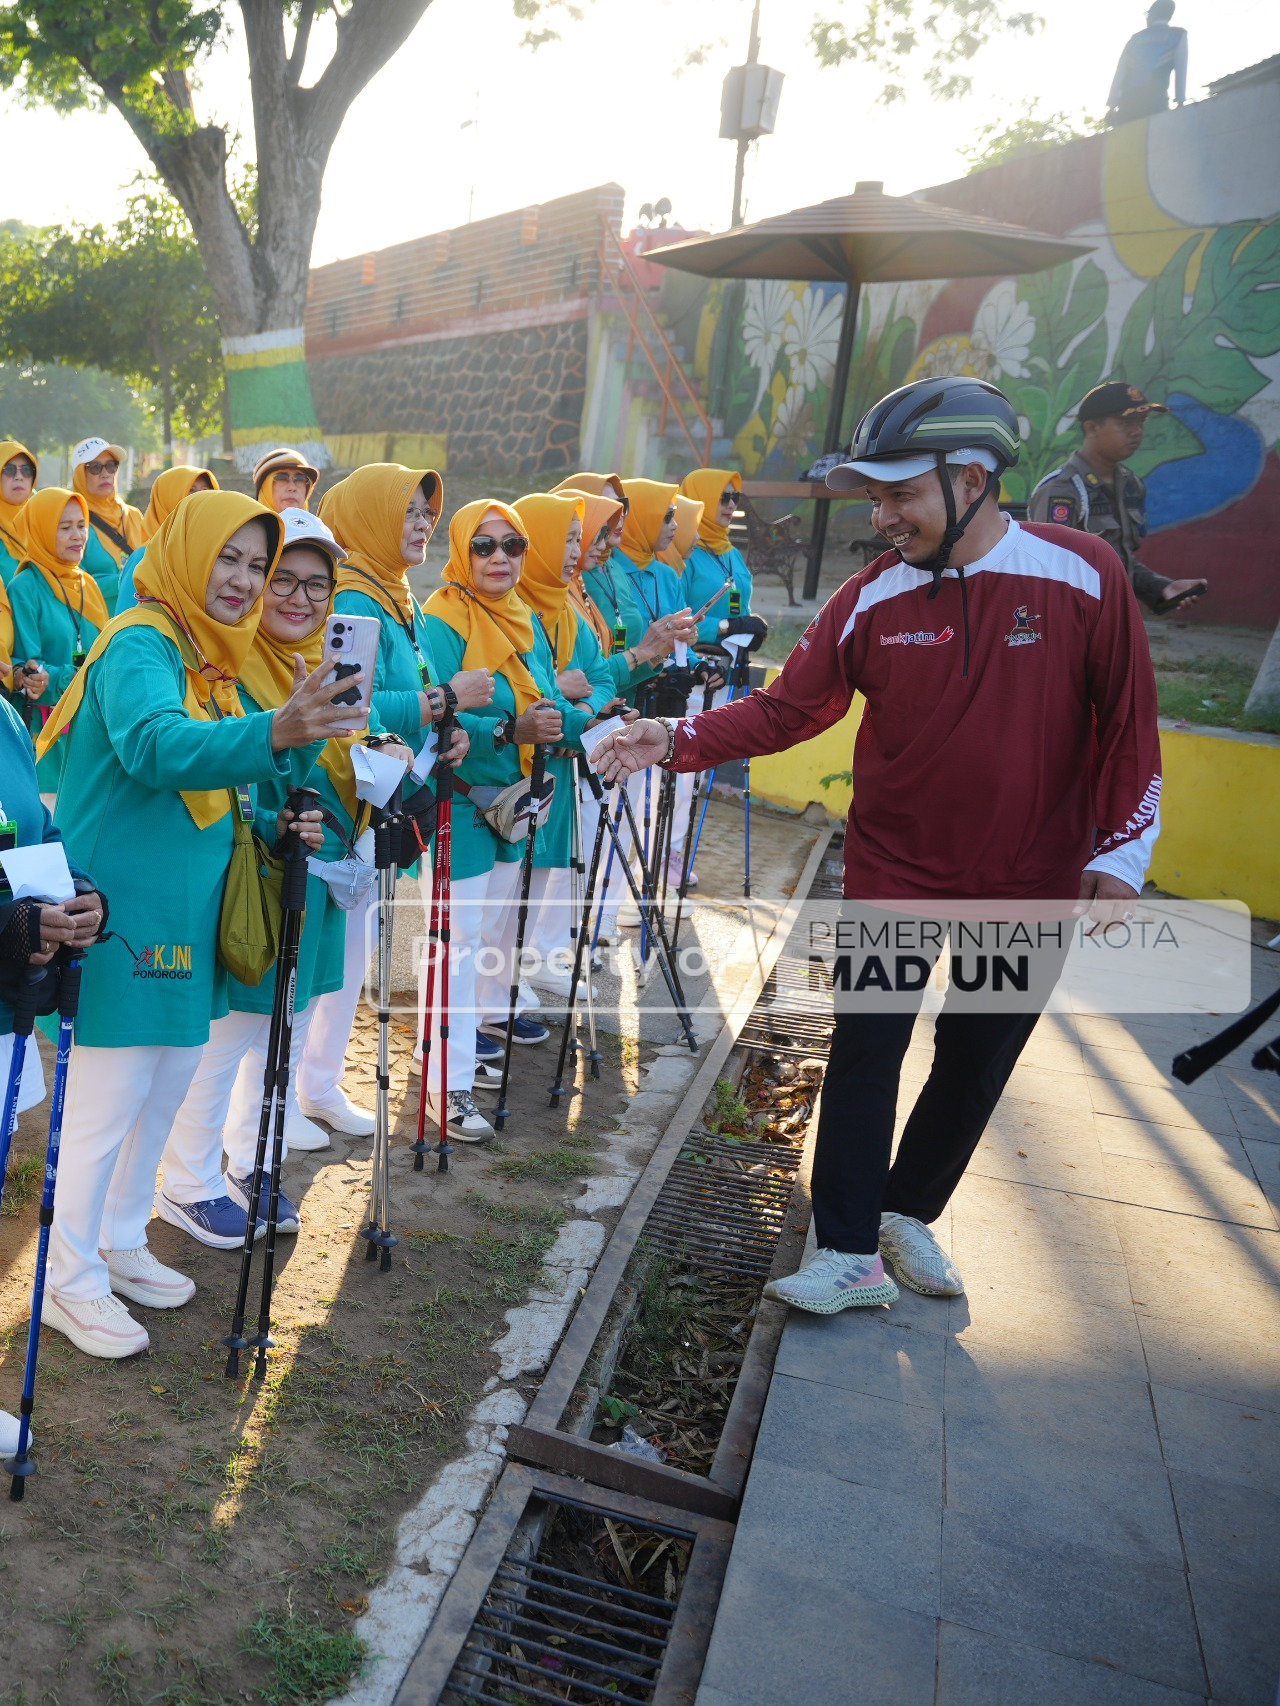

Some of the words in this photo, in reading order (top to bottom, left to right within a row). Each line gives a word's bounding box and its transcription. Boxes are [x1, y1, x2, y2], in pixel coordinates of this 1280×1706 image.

[880, 631, 935, 645] bankjatim
[154, 944, 193, 970] KJNI
[133, 969, 193, 980] PONOROGO
